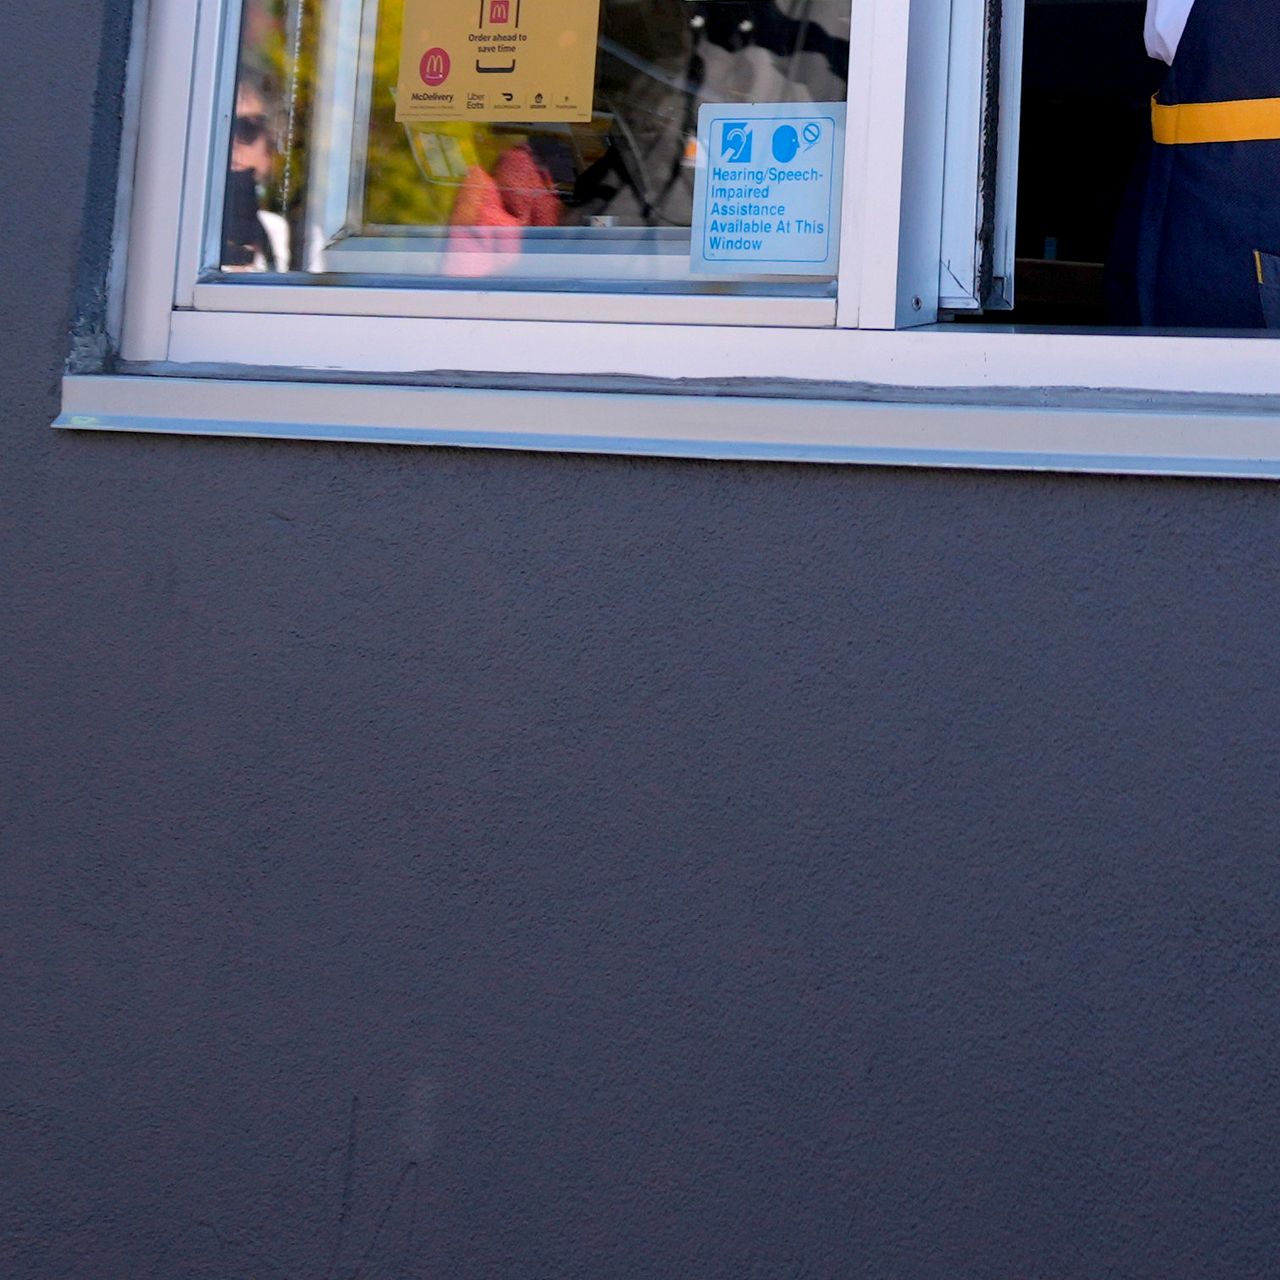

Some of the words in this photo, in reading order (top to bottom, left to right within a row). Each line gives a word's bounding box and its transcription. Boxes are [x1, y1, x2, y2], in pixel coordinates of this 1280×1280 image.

[468, 32, 491, 43] Order
[492, 32, 516, 43] ahead
[518, 33, 527, 42] to
[477, 44, 496, 53] save
[497, 43, 517, 54] time
[411, 92, 454, 103] McDelivery
[467, 92, 485, 101] Uber
[466, 101, 485, 110] Eats
[712, 167, 824, 185] Hearing/Speech-
[711, 185, 770, 201] Impaired
[710, 202, 785, 216] Assistance
[709, 219, 772, 234] Available
[776, 220, 792, 234] At
[796, 219, 824, 235] This
[709, 236, 762, 251] Window
